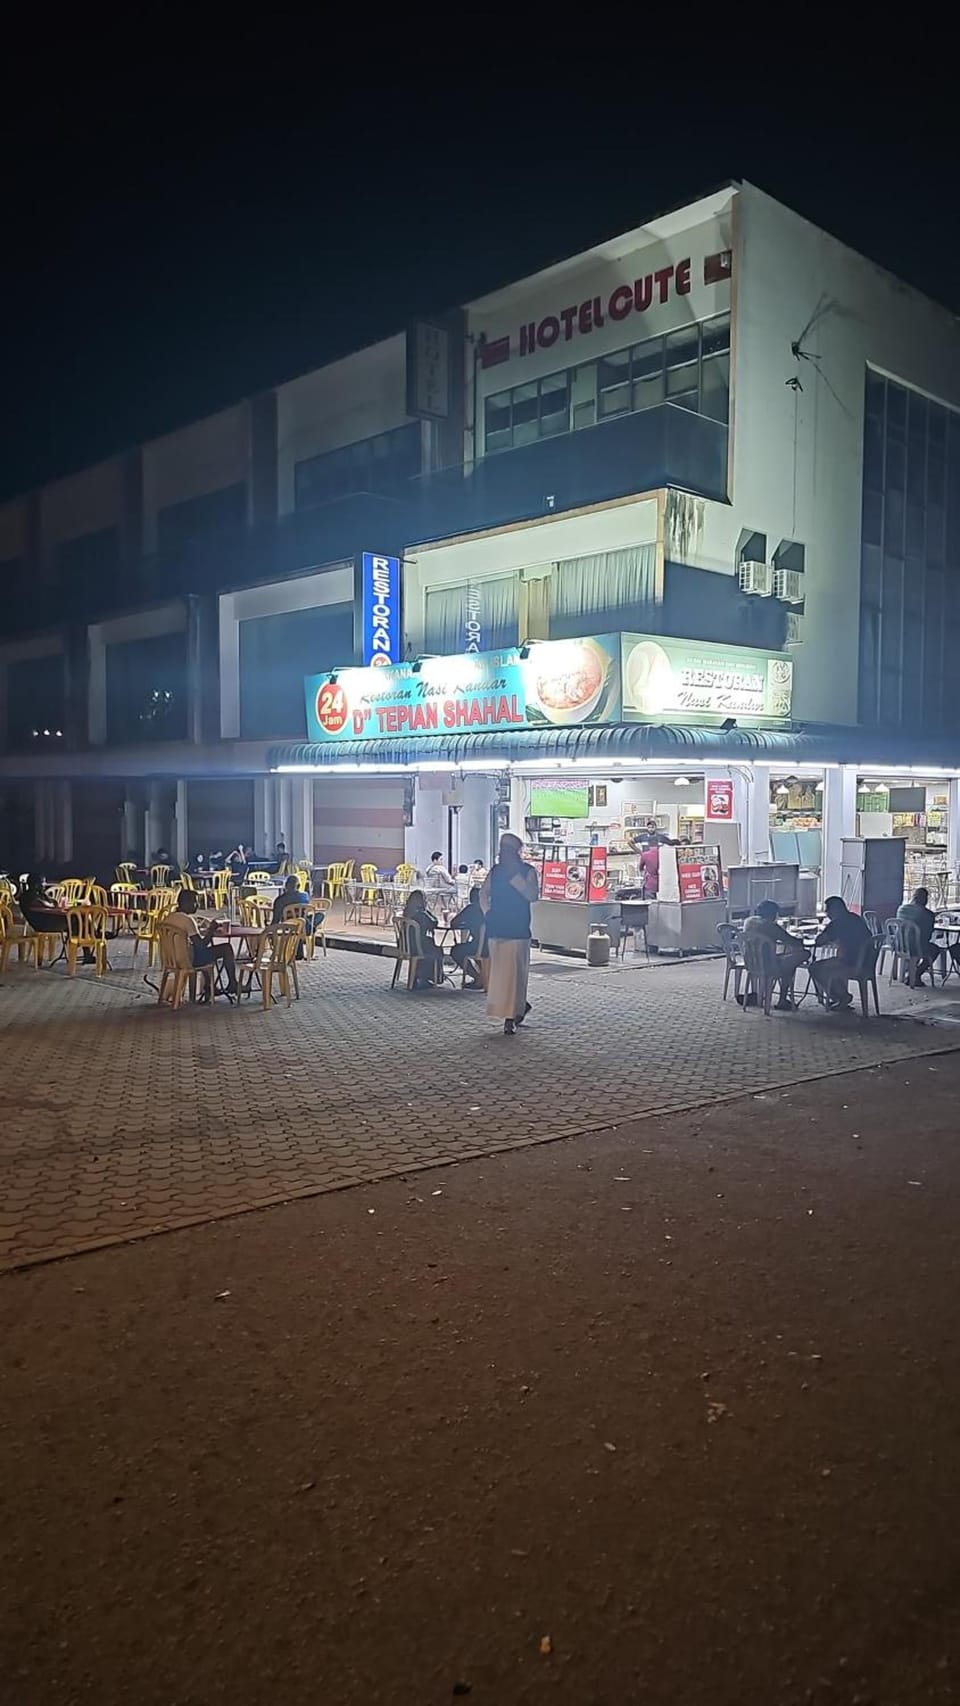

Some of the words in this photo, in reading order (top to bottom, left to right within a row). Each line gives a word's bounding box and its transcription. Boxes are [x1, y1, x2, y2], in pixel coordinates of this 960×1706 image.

[519, 296, 604, 357] HOTEL
[608, 256, 691, 321] CUTE
[372, 556, 390, 652] RESTORAN
[320, 689, 345, 715] 24
[416, 680, 448, 698] Nasi
[322, 714, 344, 726] Jam
[375, 703, 438, 734] TEPIAN
[443, 694, 524, 728] SHAHAL
